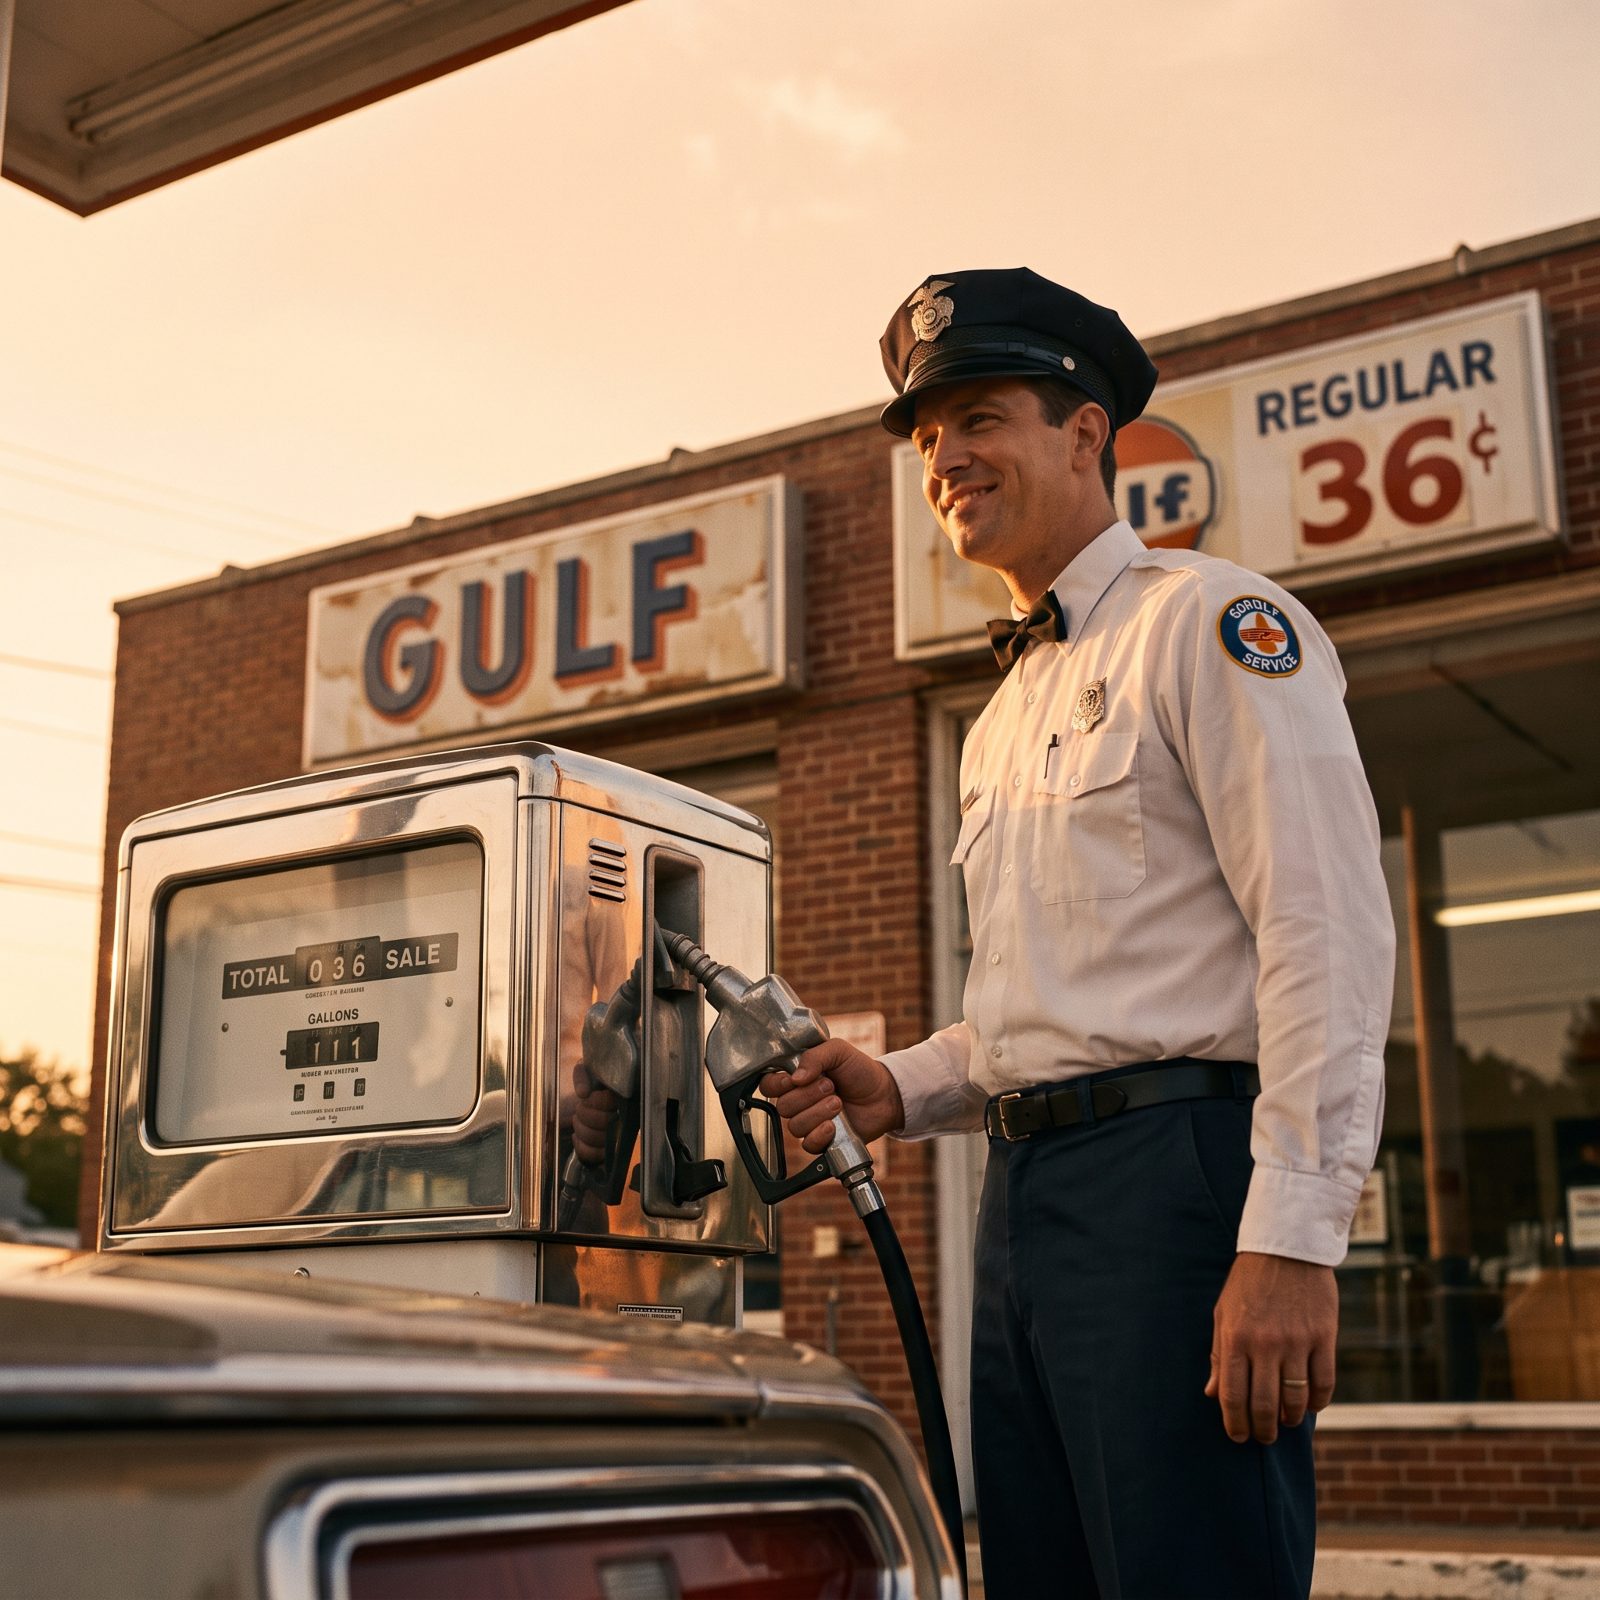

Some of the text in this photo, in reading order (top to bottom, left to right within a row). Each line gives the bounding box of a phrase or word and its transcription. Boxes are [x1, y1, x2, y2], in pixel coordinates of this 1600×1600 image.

[1256, 340, 1496, 437] REGULAR
[1127, 473, 1192, 529] lf
[363, 528, 706, 726] GULF
[1242, 652, 1298, 672] SERVICE
[229, 964, 290, 990] TOTAL
[385, 943, 441, 971] SALE
[307, 1008, 359, 1025] GALLONS
